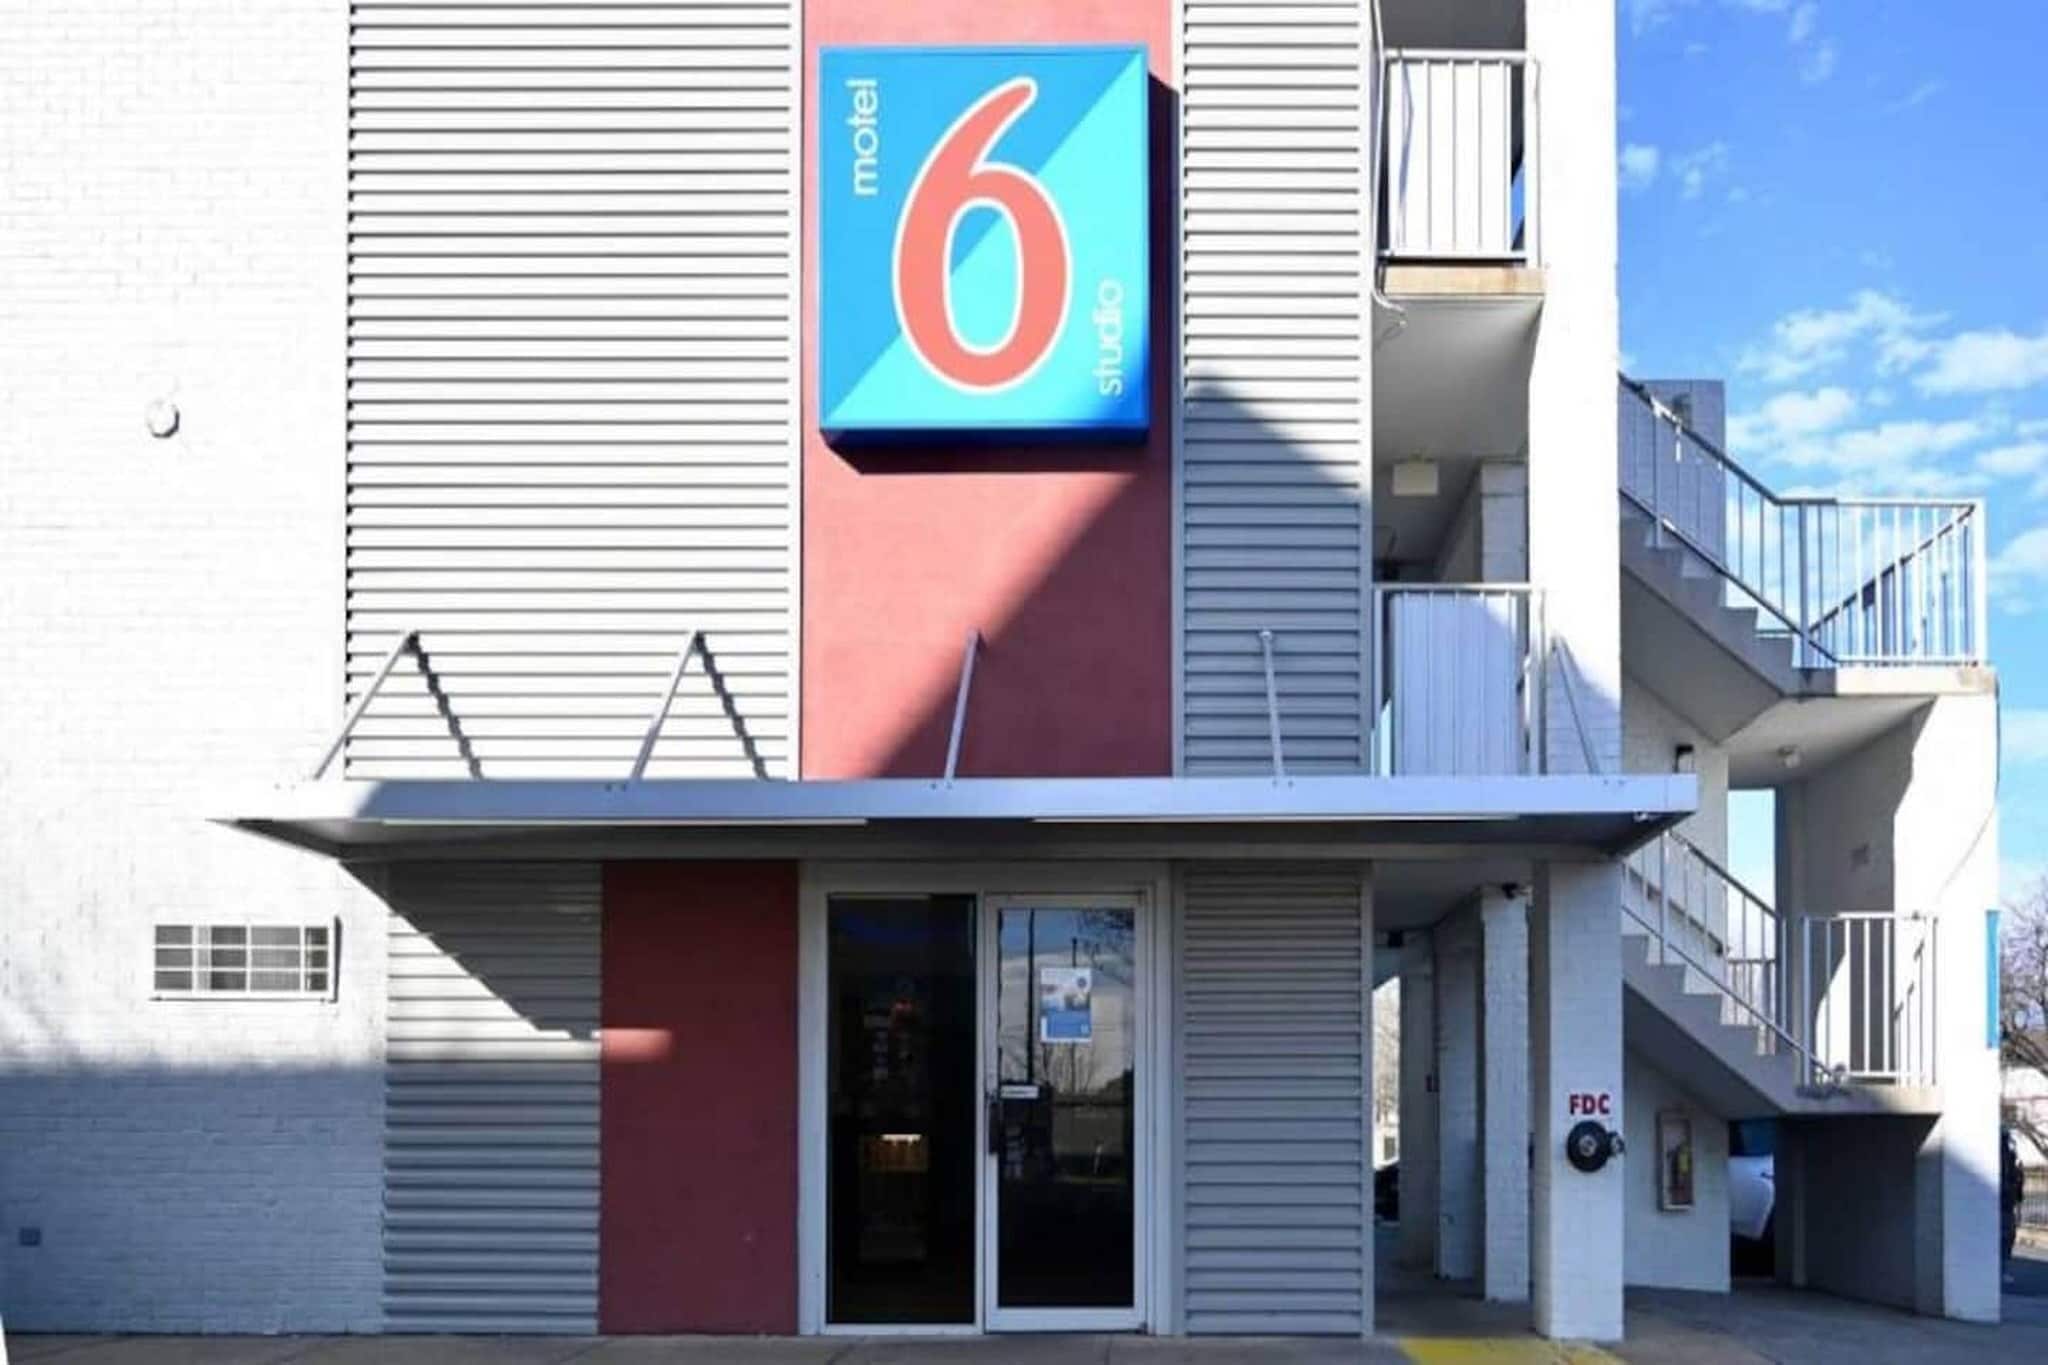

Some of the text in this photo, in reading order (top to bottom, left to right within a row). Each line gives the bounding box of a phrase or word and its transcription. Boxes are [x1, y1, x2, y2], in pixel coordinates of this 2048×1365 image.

[846, 78, 879, 196] motel
[892, 75, 1074, 396] 6
[1093, 278, 1125, 396] studio
[1569, 1093, 1610, 1116] FDC
